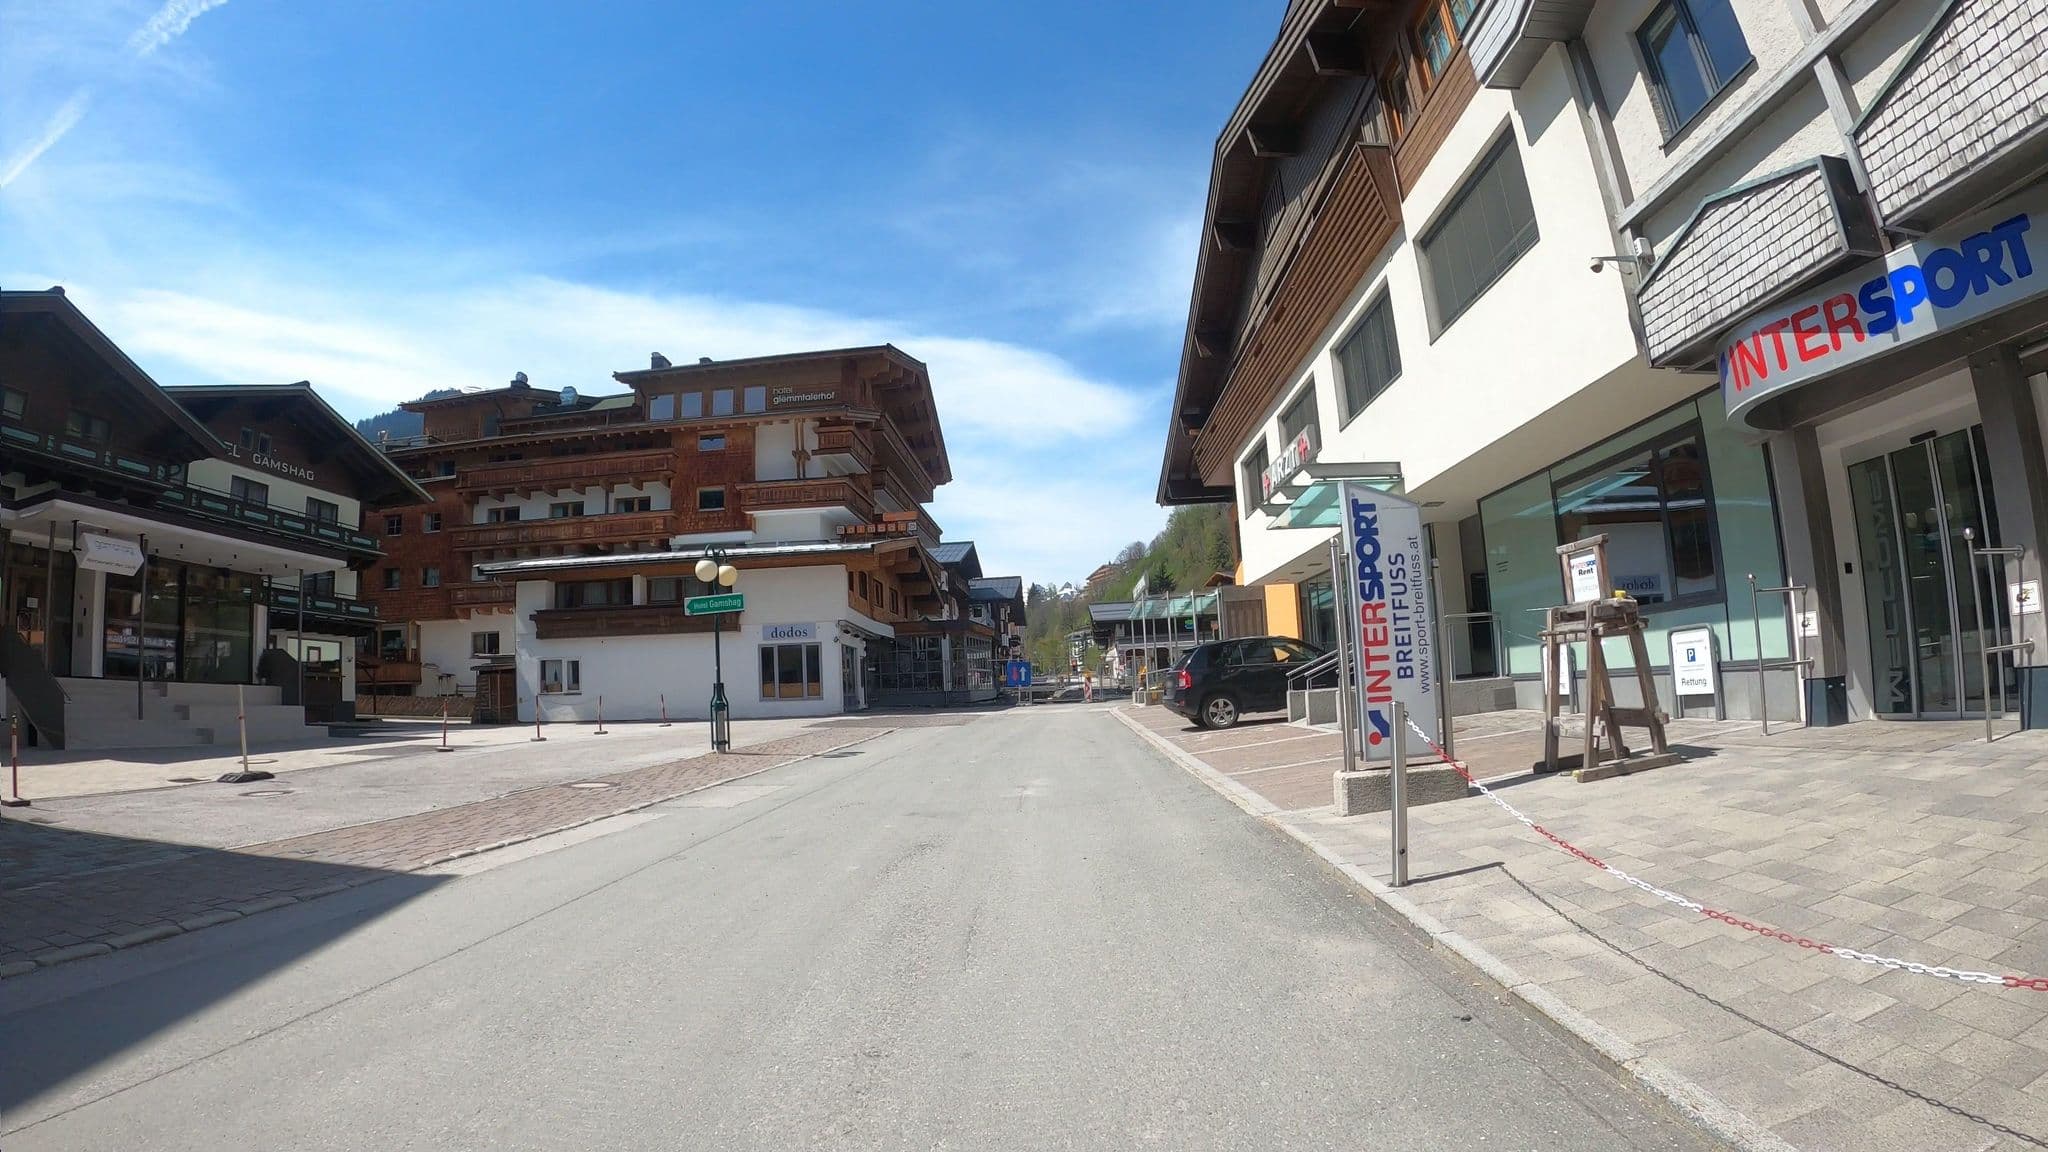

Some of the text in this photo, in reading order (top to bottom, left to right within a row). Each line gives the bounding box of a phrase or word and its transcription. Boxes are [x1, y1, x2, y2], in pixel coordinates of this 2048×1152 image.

[1728, 213, 2033, 392] INTERSPORT
[252, 453, 315, 481] GAMSHAG
[1271, 443, 1298, 488] ARZT
[1578, 567, 1594, 577] Rent
[709, 599, 742, 608] Gamshag
[1351, 498, 1393, 704] INTERSPORT
[1388, 553, 1415, 680] BREITFUSS
[1407, 535, 1431, 695] www.sport-breitfuss.at
[771, 626, 808, 639] dodos
[1681, 678, 1708, 687] Rettung
